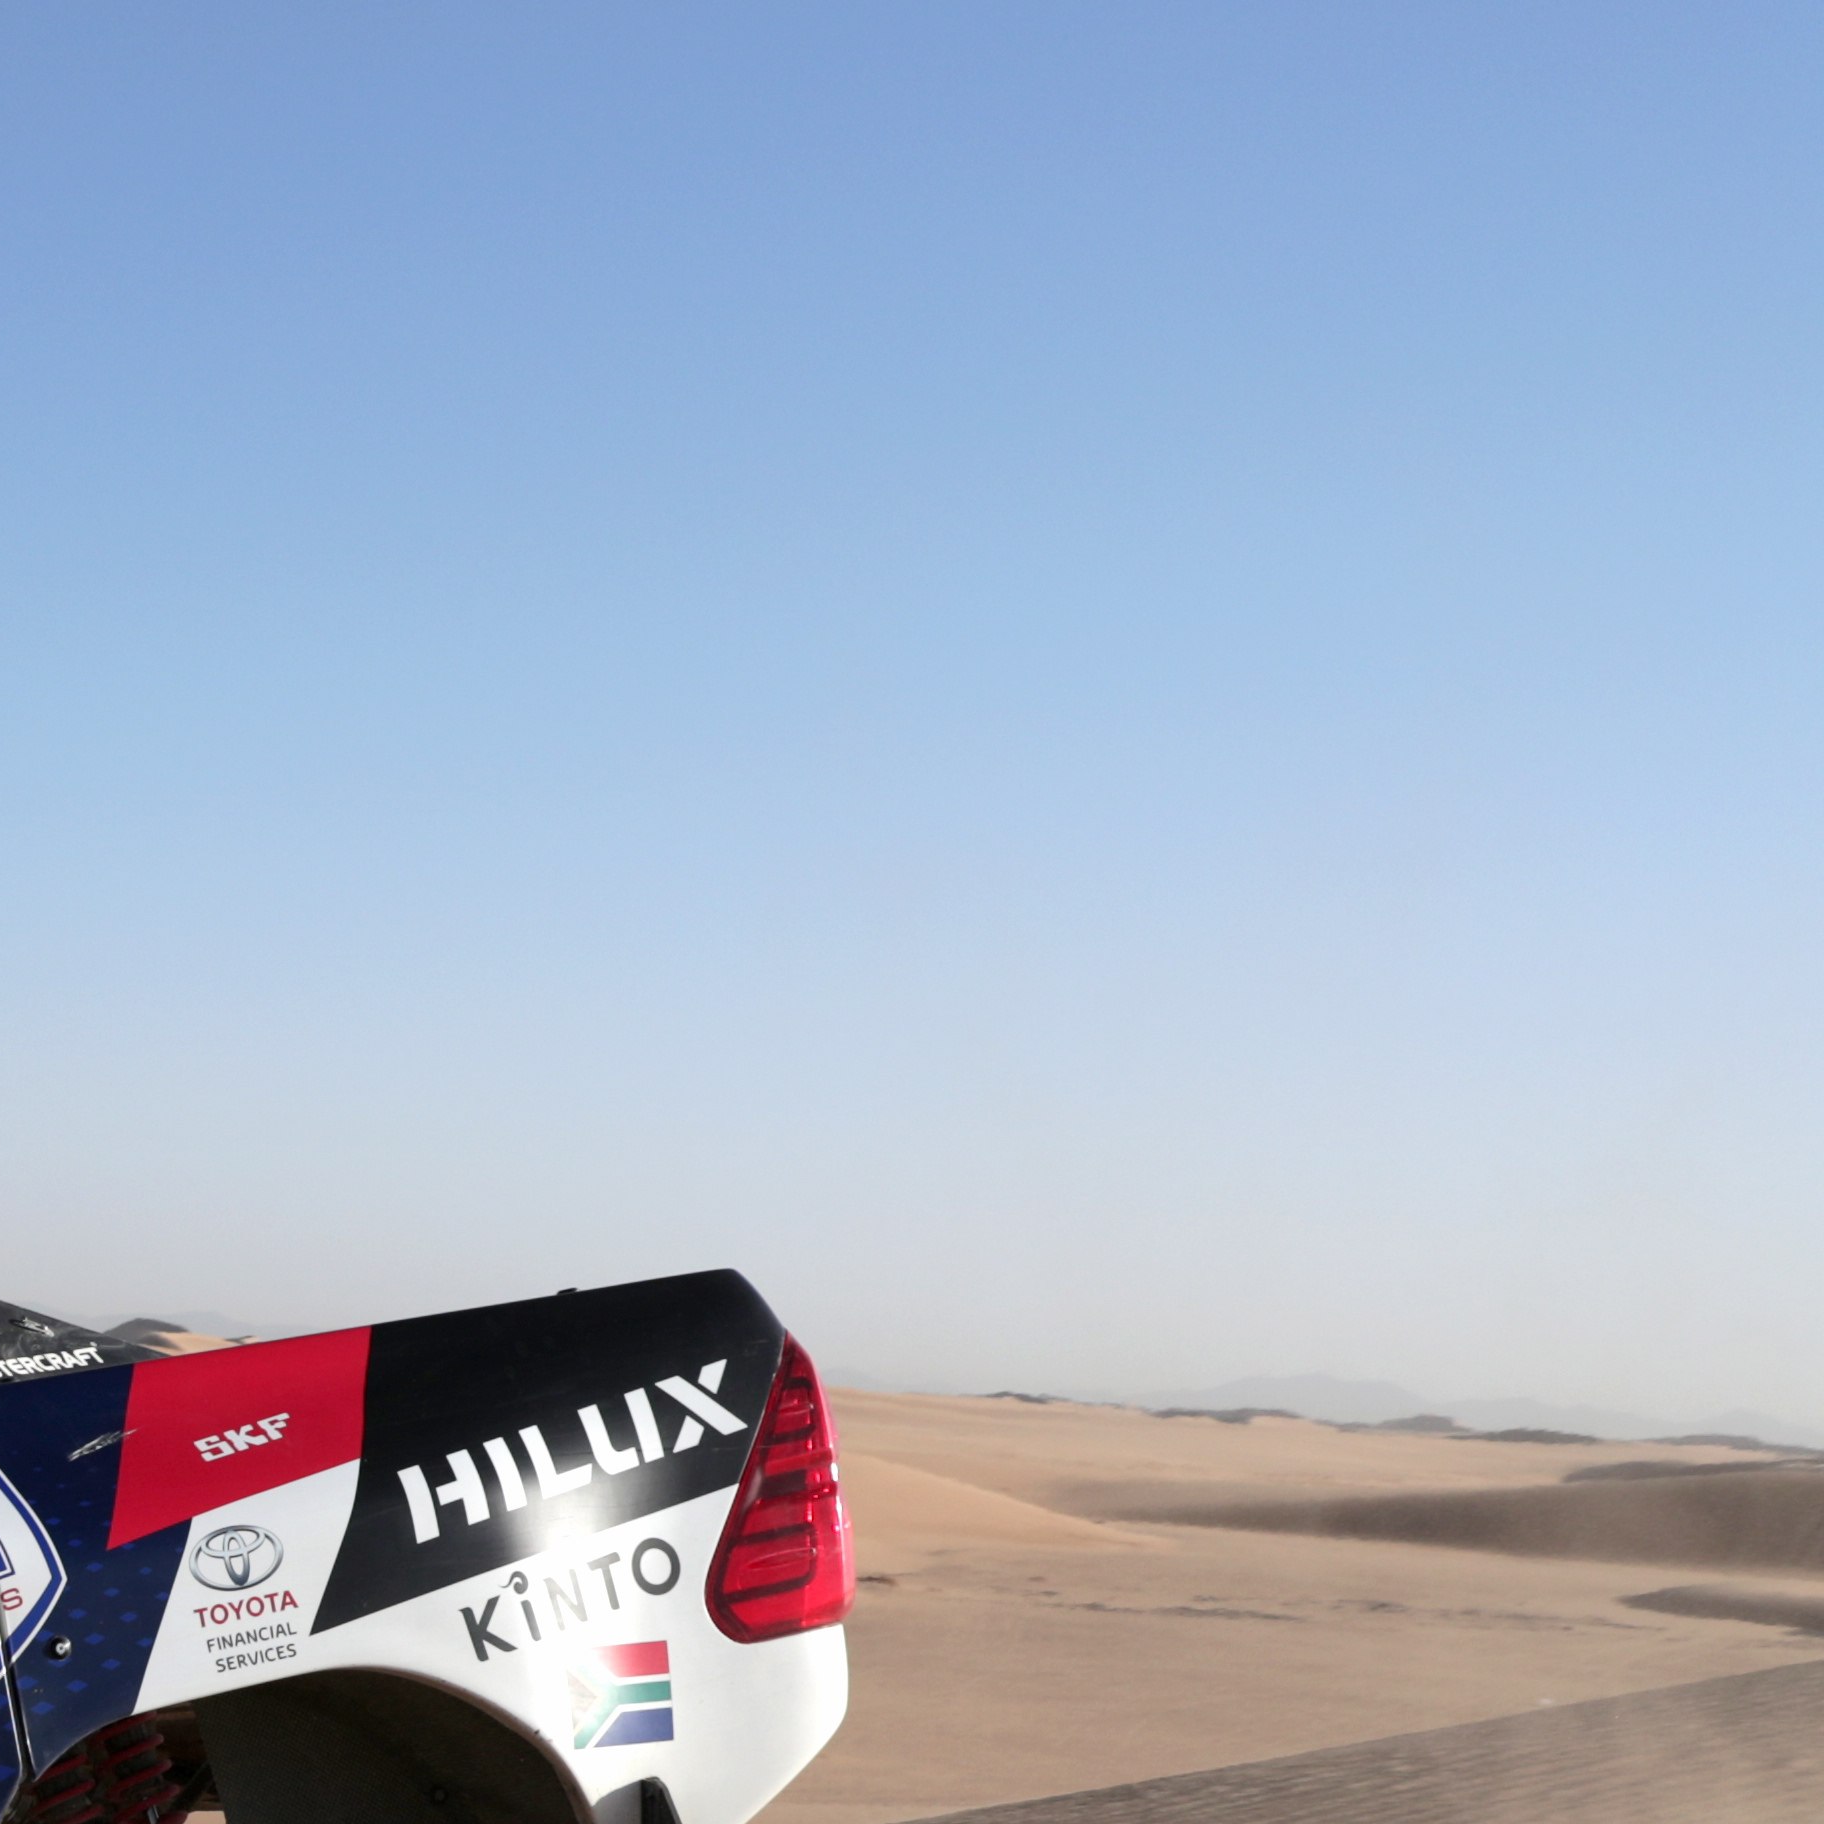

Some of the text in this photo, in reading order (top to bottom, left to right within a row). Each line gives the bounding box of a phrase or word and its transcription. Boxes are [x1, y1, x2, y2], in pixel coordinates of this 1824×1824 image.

[194, 1412, 291, 1462] SKF
[397, 1358, 748, 1545] HILUX
[193, 1590, 299, 1628] TOYOTA
[206, 1622, 297, 1653] FINANCIAL
[215, 1644, 297, 1673] SERVICES
